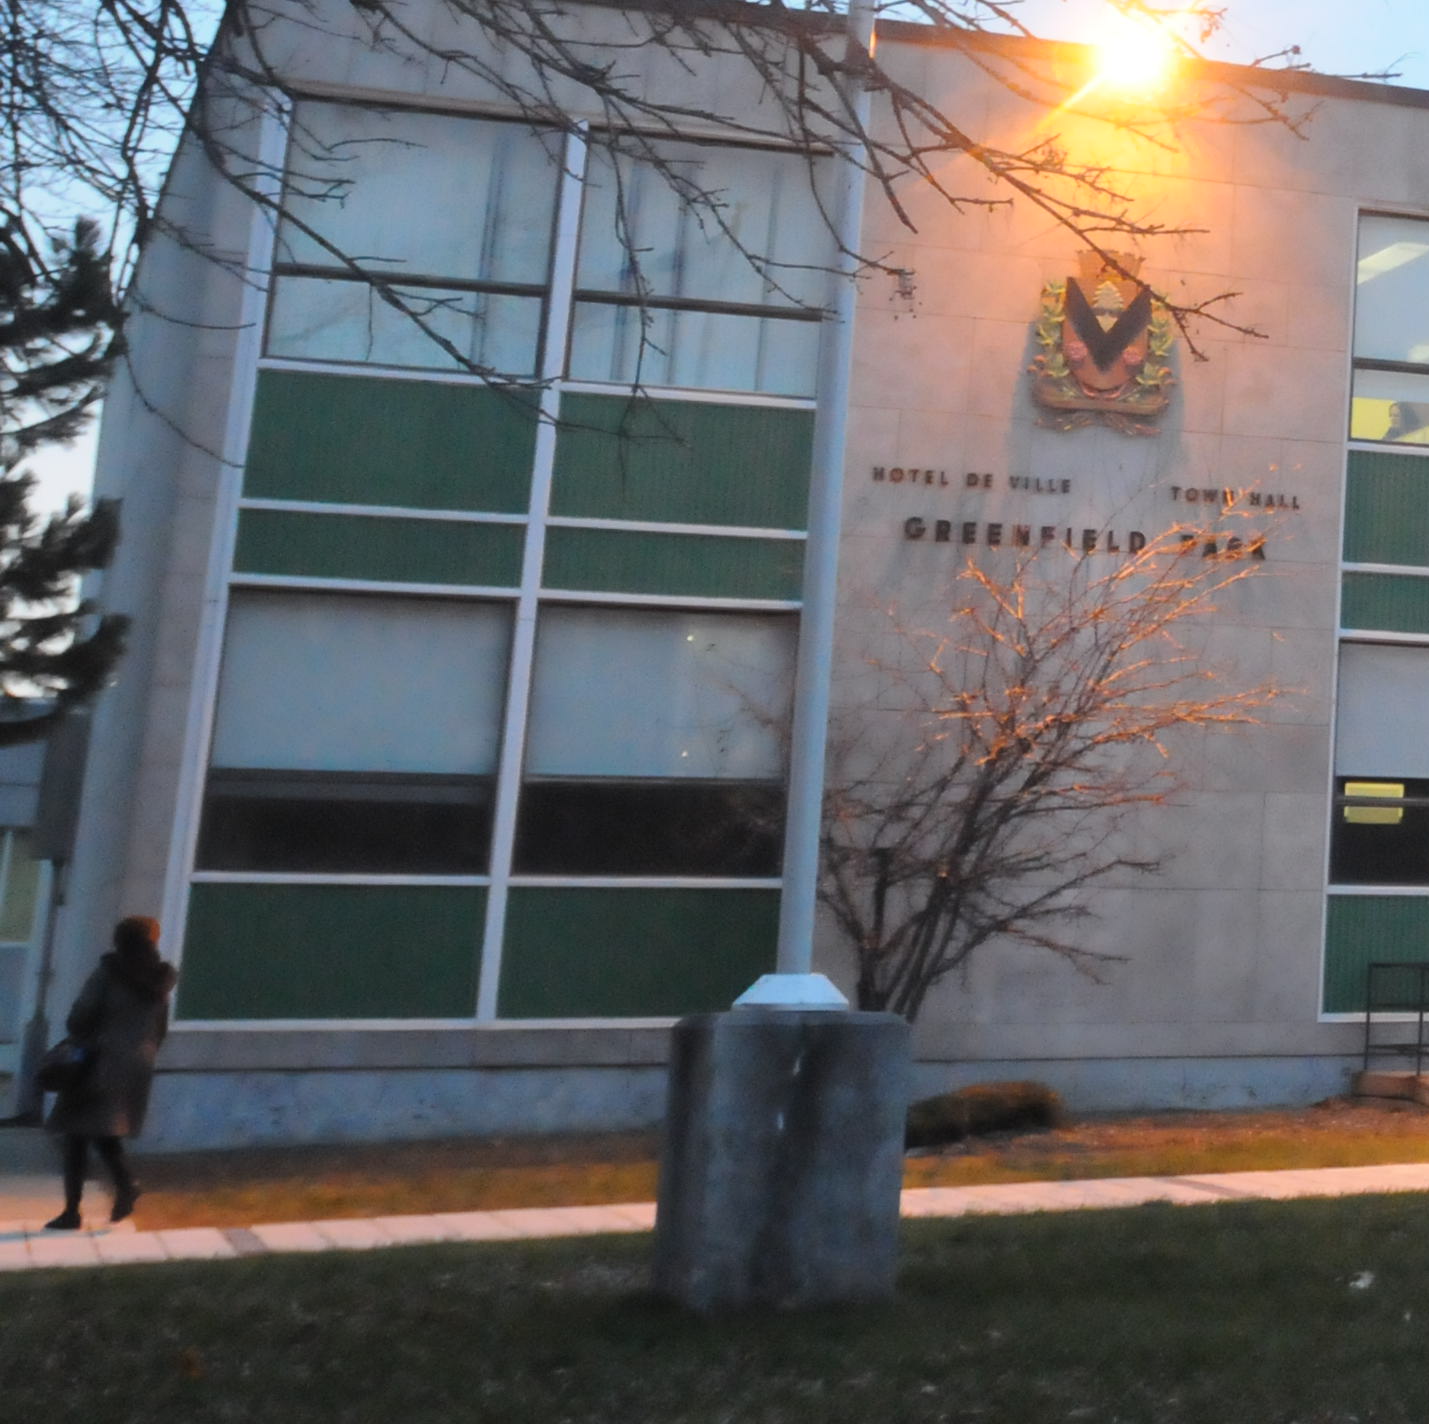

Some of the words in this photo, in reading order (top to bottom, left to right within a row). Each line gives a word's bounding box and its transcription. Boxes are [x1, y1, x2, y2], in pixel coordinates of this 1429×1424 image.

[872, 466, 950, 487] HOTEL
[965, 472, 994, 489] DE
[1008, 475, 1071, 494] VILLE
[1249, 491, 1300, 511] HALL
[903, 516, 1147, 555] GREENFIELD
